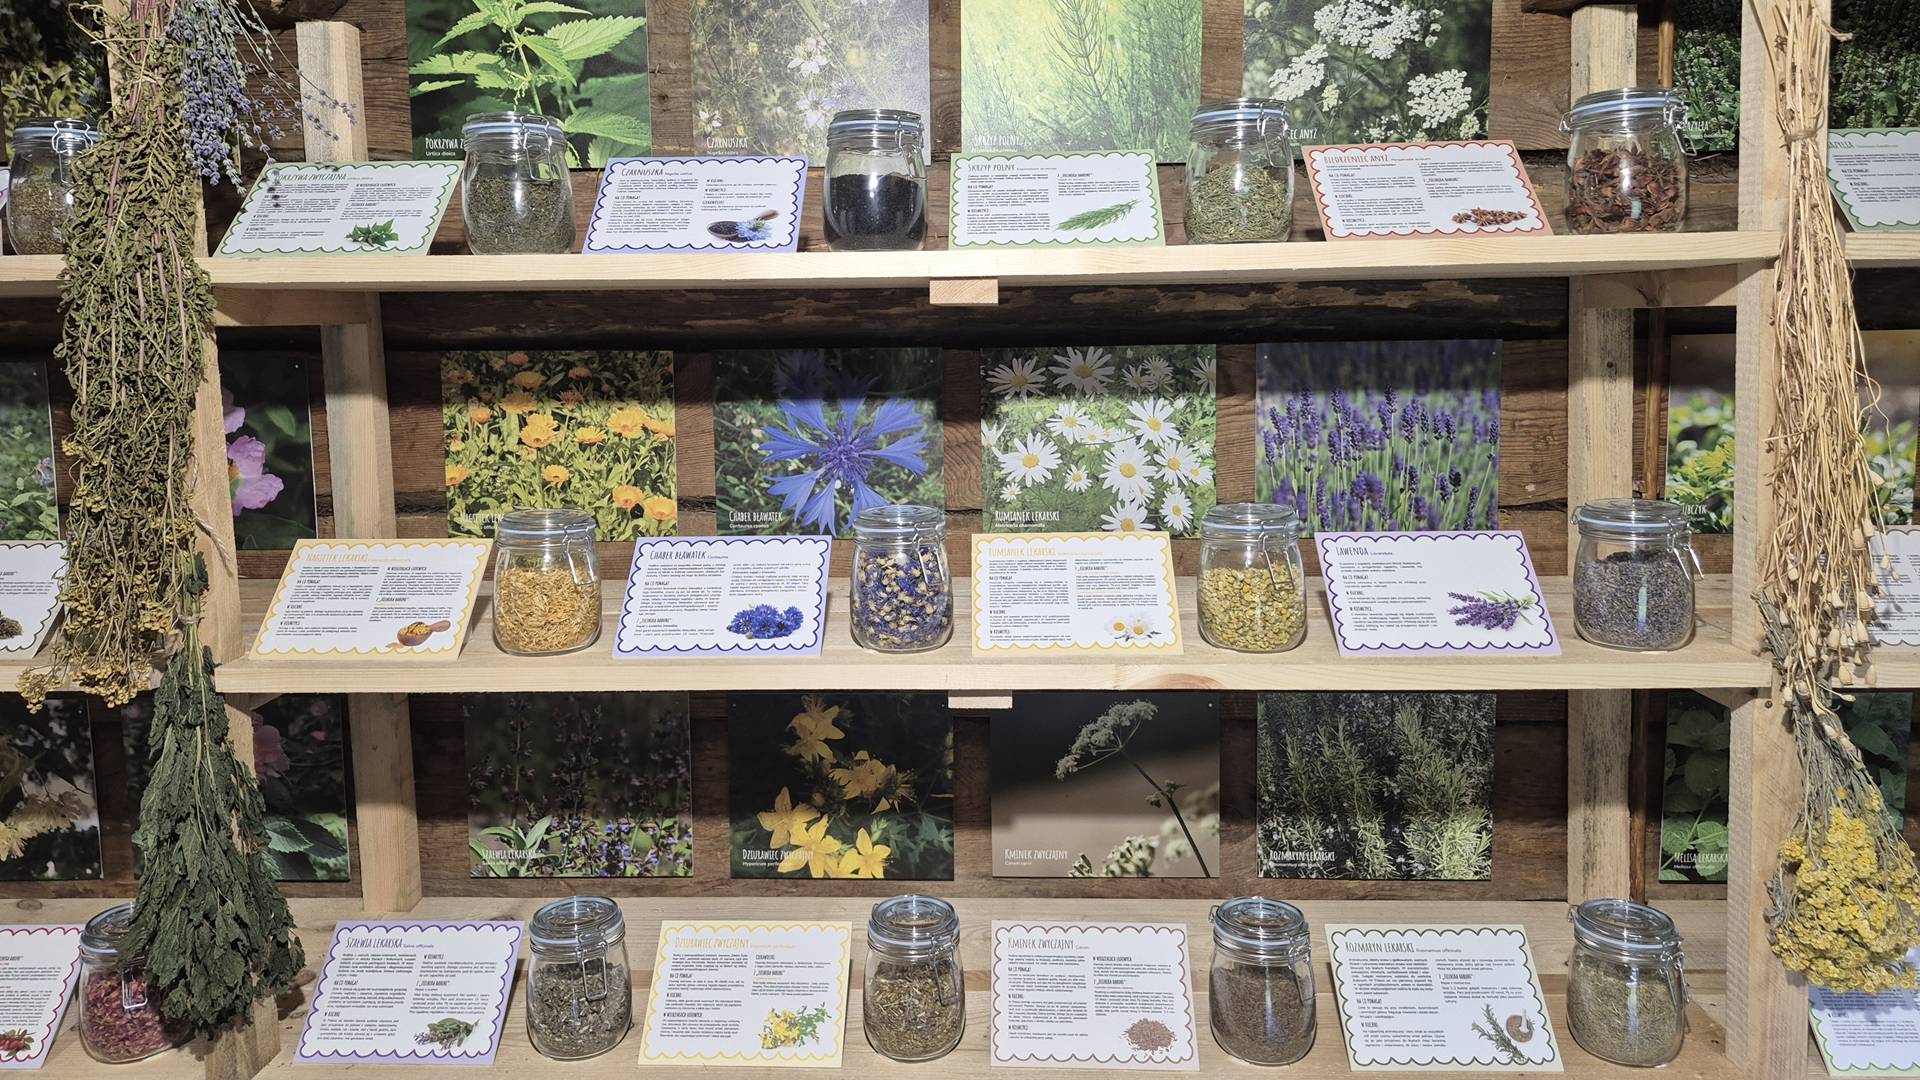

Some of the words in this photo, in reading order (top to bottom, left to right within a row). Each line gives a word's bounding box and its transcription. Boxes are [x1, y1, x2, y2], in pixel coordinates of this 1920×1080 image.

[425, 138, 459, 150] POKRZYWA
[706, 137, 748, 149] CZARNUSZKA
[1323, 155, 1369, 164] BIEDRZENIEC
[621, 168, 663, 177] CZARNUSZKA
[967, 163, 992, 172] SKRZYP
[993, 163, 1015, 171] POLNY
[729, 511, 751, 522] CHABER
[752, 511, 783, 522] BŁAWATEK
[995, 511, 1030, 521] RUMIANEK
[1031, 511, 1060, 521] LEKARSKI
[650, 551, 673, 560] CHABER
[674, 551, 707, 560] BŁAWATEK
[1336, 547, 1369, 556] LAWENDA
[742, 849, 779, 860] DZIURAWIEC
[1005, 849, 1033, 860] KMINEK
[1034, 849, 1068, 861] ZWYCZAJNY
[1674, 852, 1696, 863] MELISA
[346, 937, 373, 948] SZAŁWIA
[373, 937, 403, 948] LEKARSKA
[1008, 938, 1037, 949] KMINEK
[1037, 938, 1075, 950] ZWYCZAJNY
[1345, 942, 1383, 953] ROZMARYN
[1384, 943, 1415, 953] LEKARSKI
